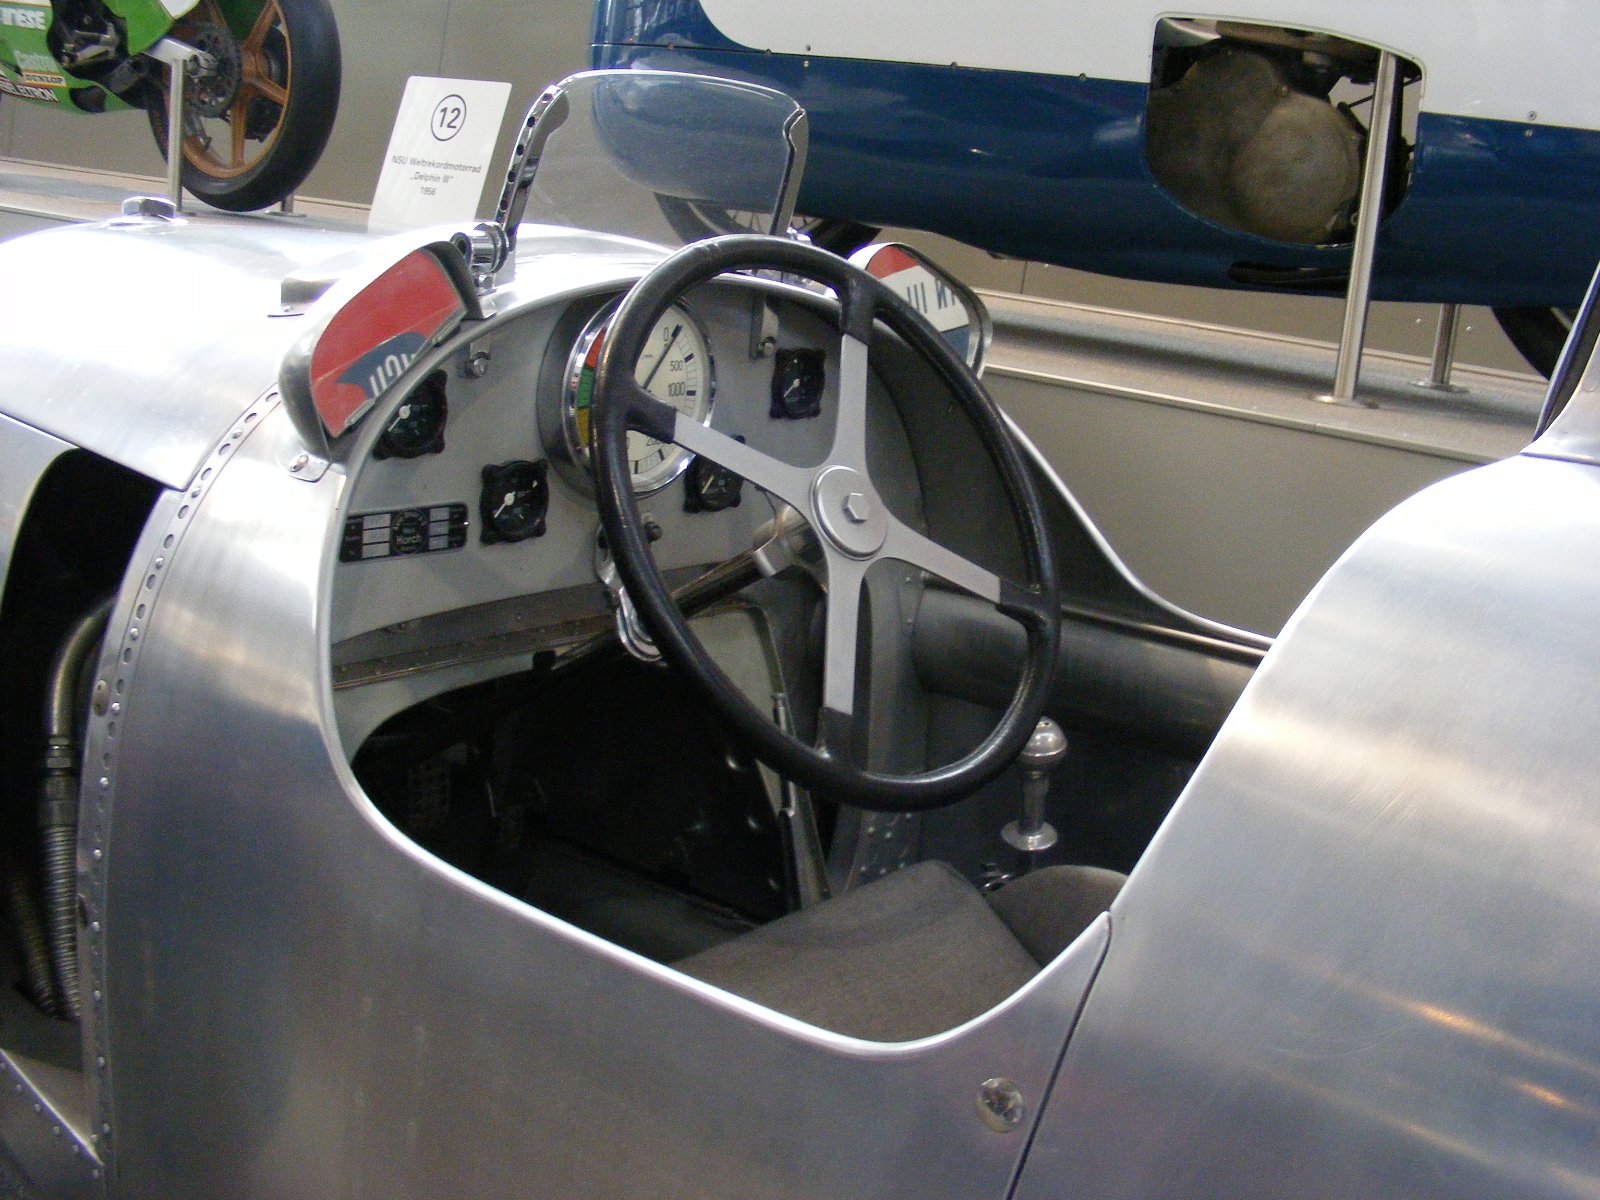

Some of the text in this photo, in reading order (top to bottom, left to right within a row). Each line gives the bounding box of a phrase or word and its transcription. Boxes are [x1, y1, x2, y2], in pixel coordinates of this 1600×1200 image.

[439, 107, 461, 128] 12
[392, 155, 482, 174] NSU Weltrekordmotorrad
[663, 327, 670, 341] 0
[670, 360, 684, 372] 500
[668, 381, 686, 397] 1000
